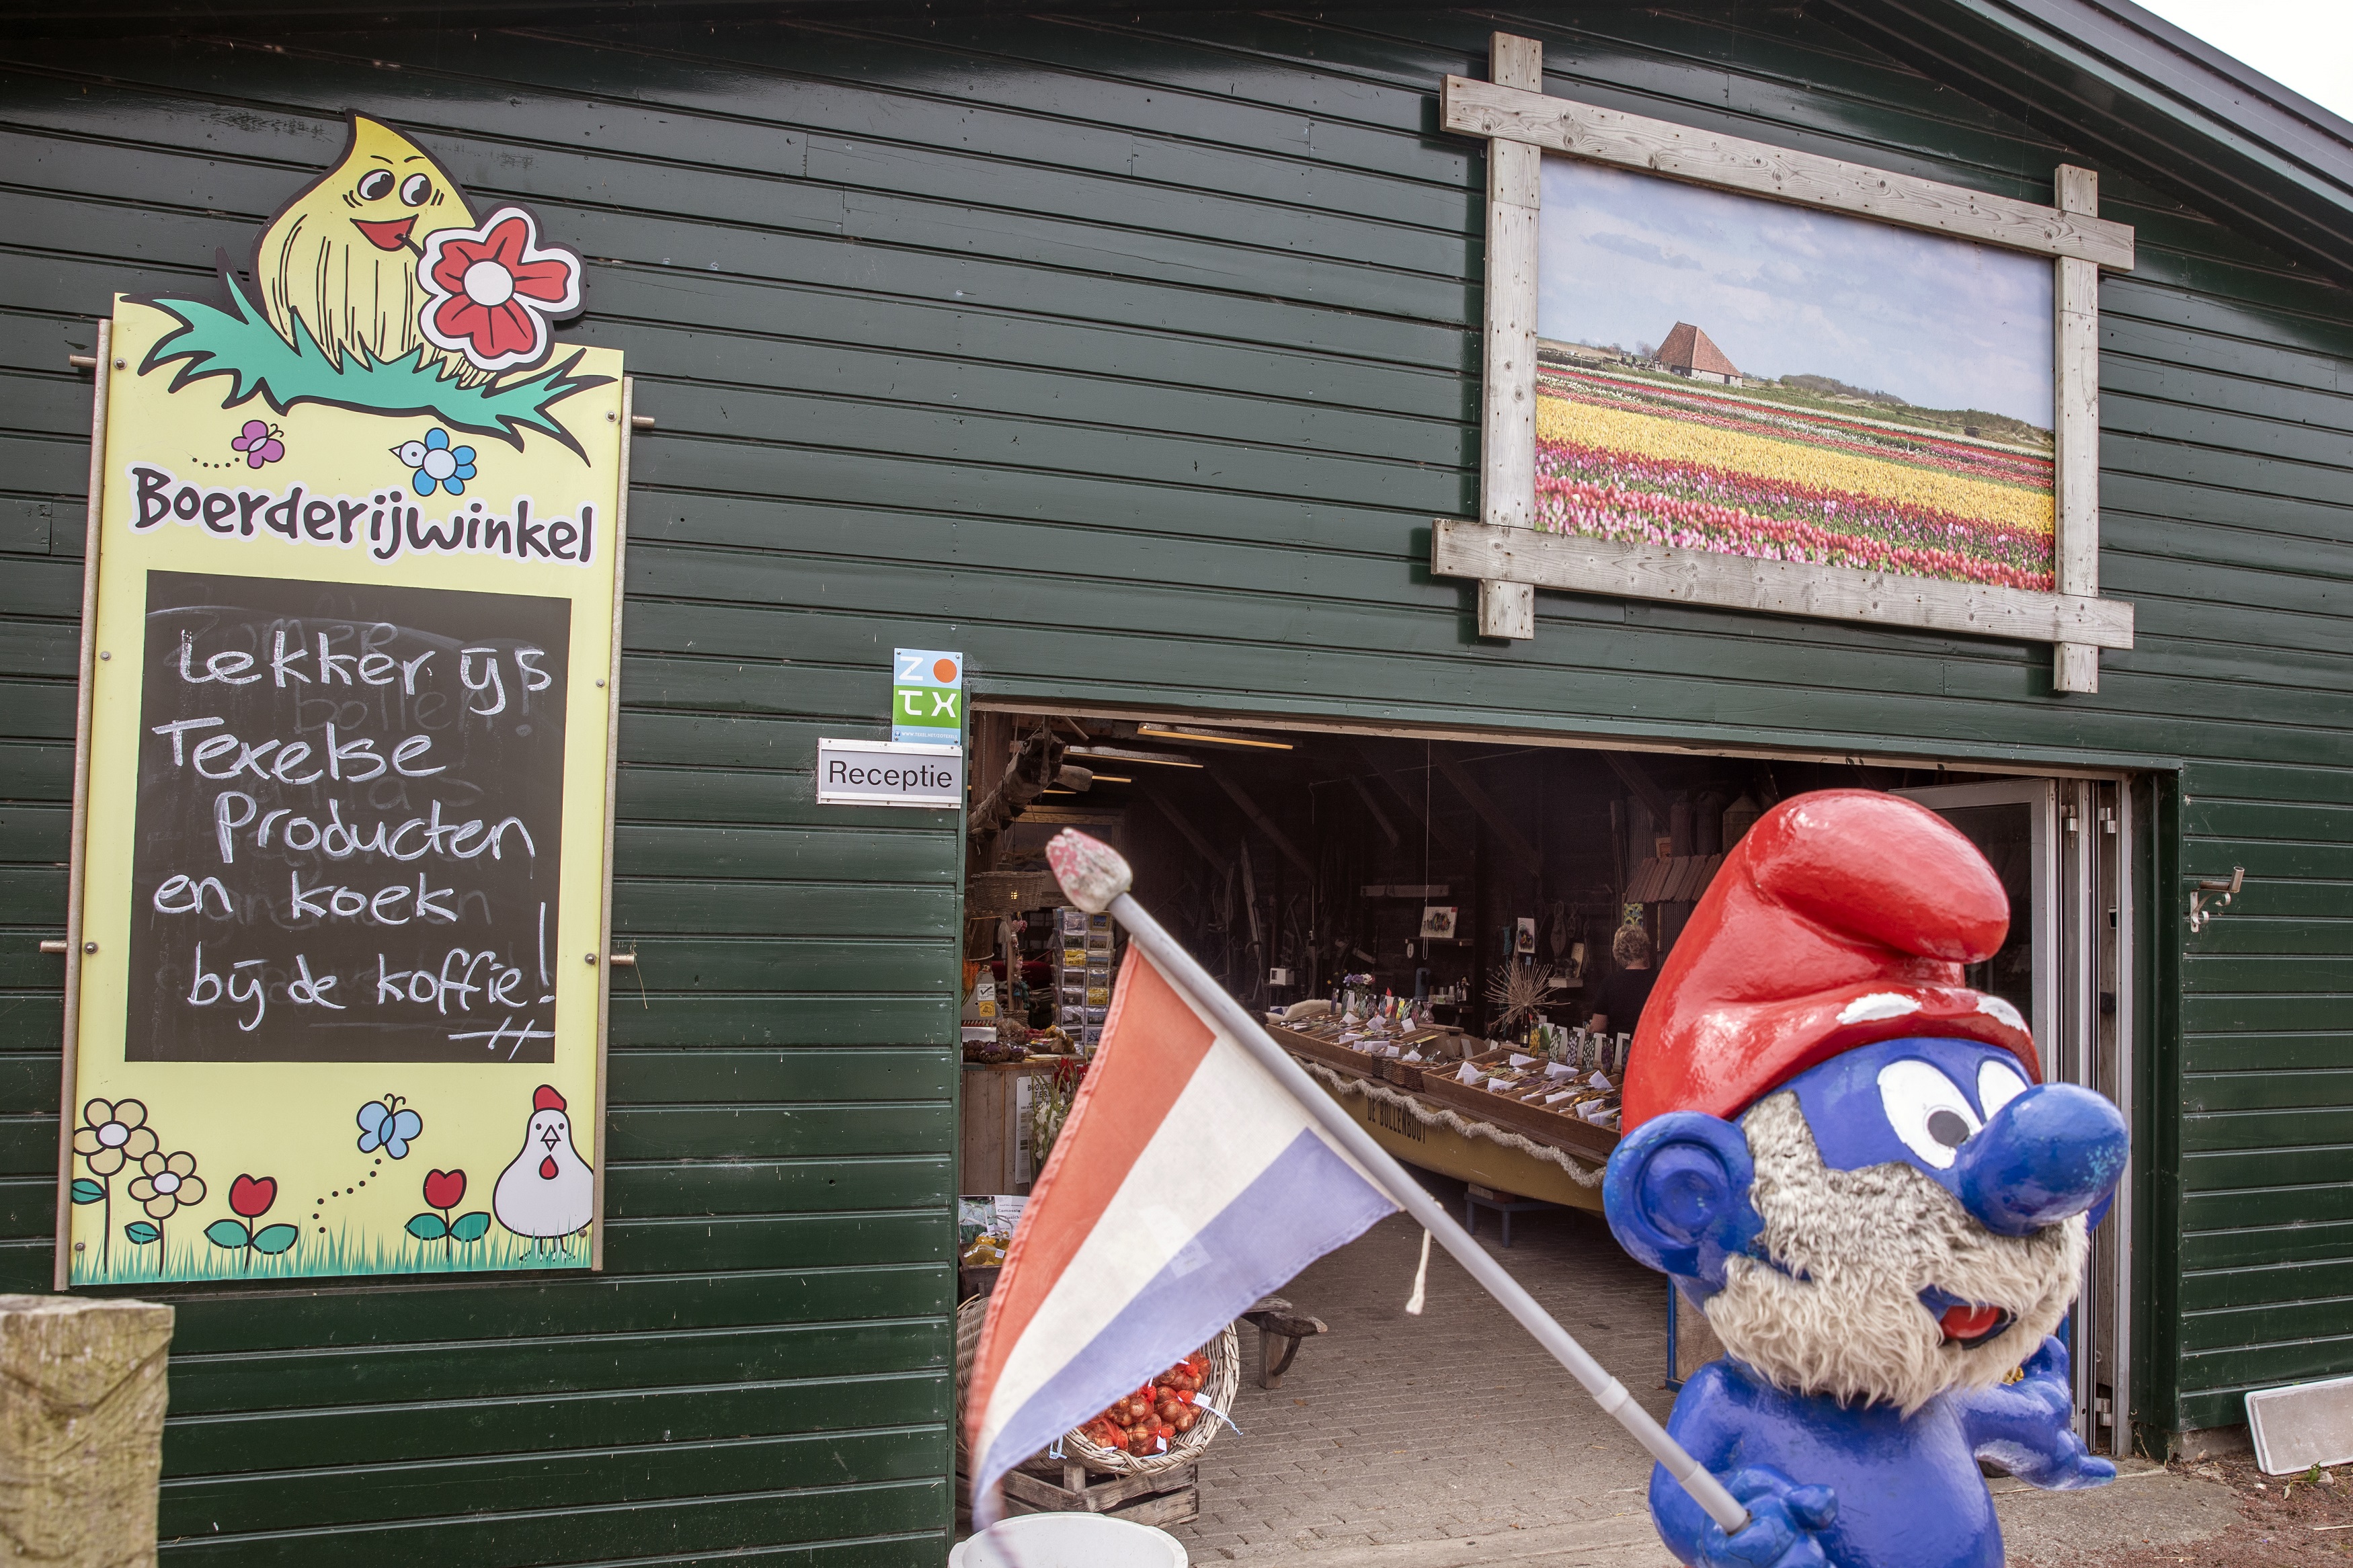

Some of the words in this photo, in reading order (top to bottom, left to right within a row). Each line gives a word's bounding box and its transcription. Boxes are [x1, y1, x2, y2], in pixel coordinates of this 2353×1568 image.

[131, 467, 594, 563] Boerderijwinkel
[151, 716, 447, 785] Texelse
[829, 760, 953, 791] Receptie
[213, 790, 536, 864] Producten
[153, 873, 234, 915] en
[291, 870, 458, 925] koek
[287, 953, 348, 1010] de
